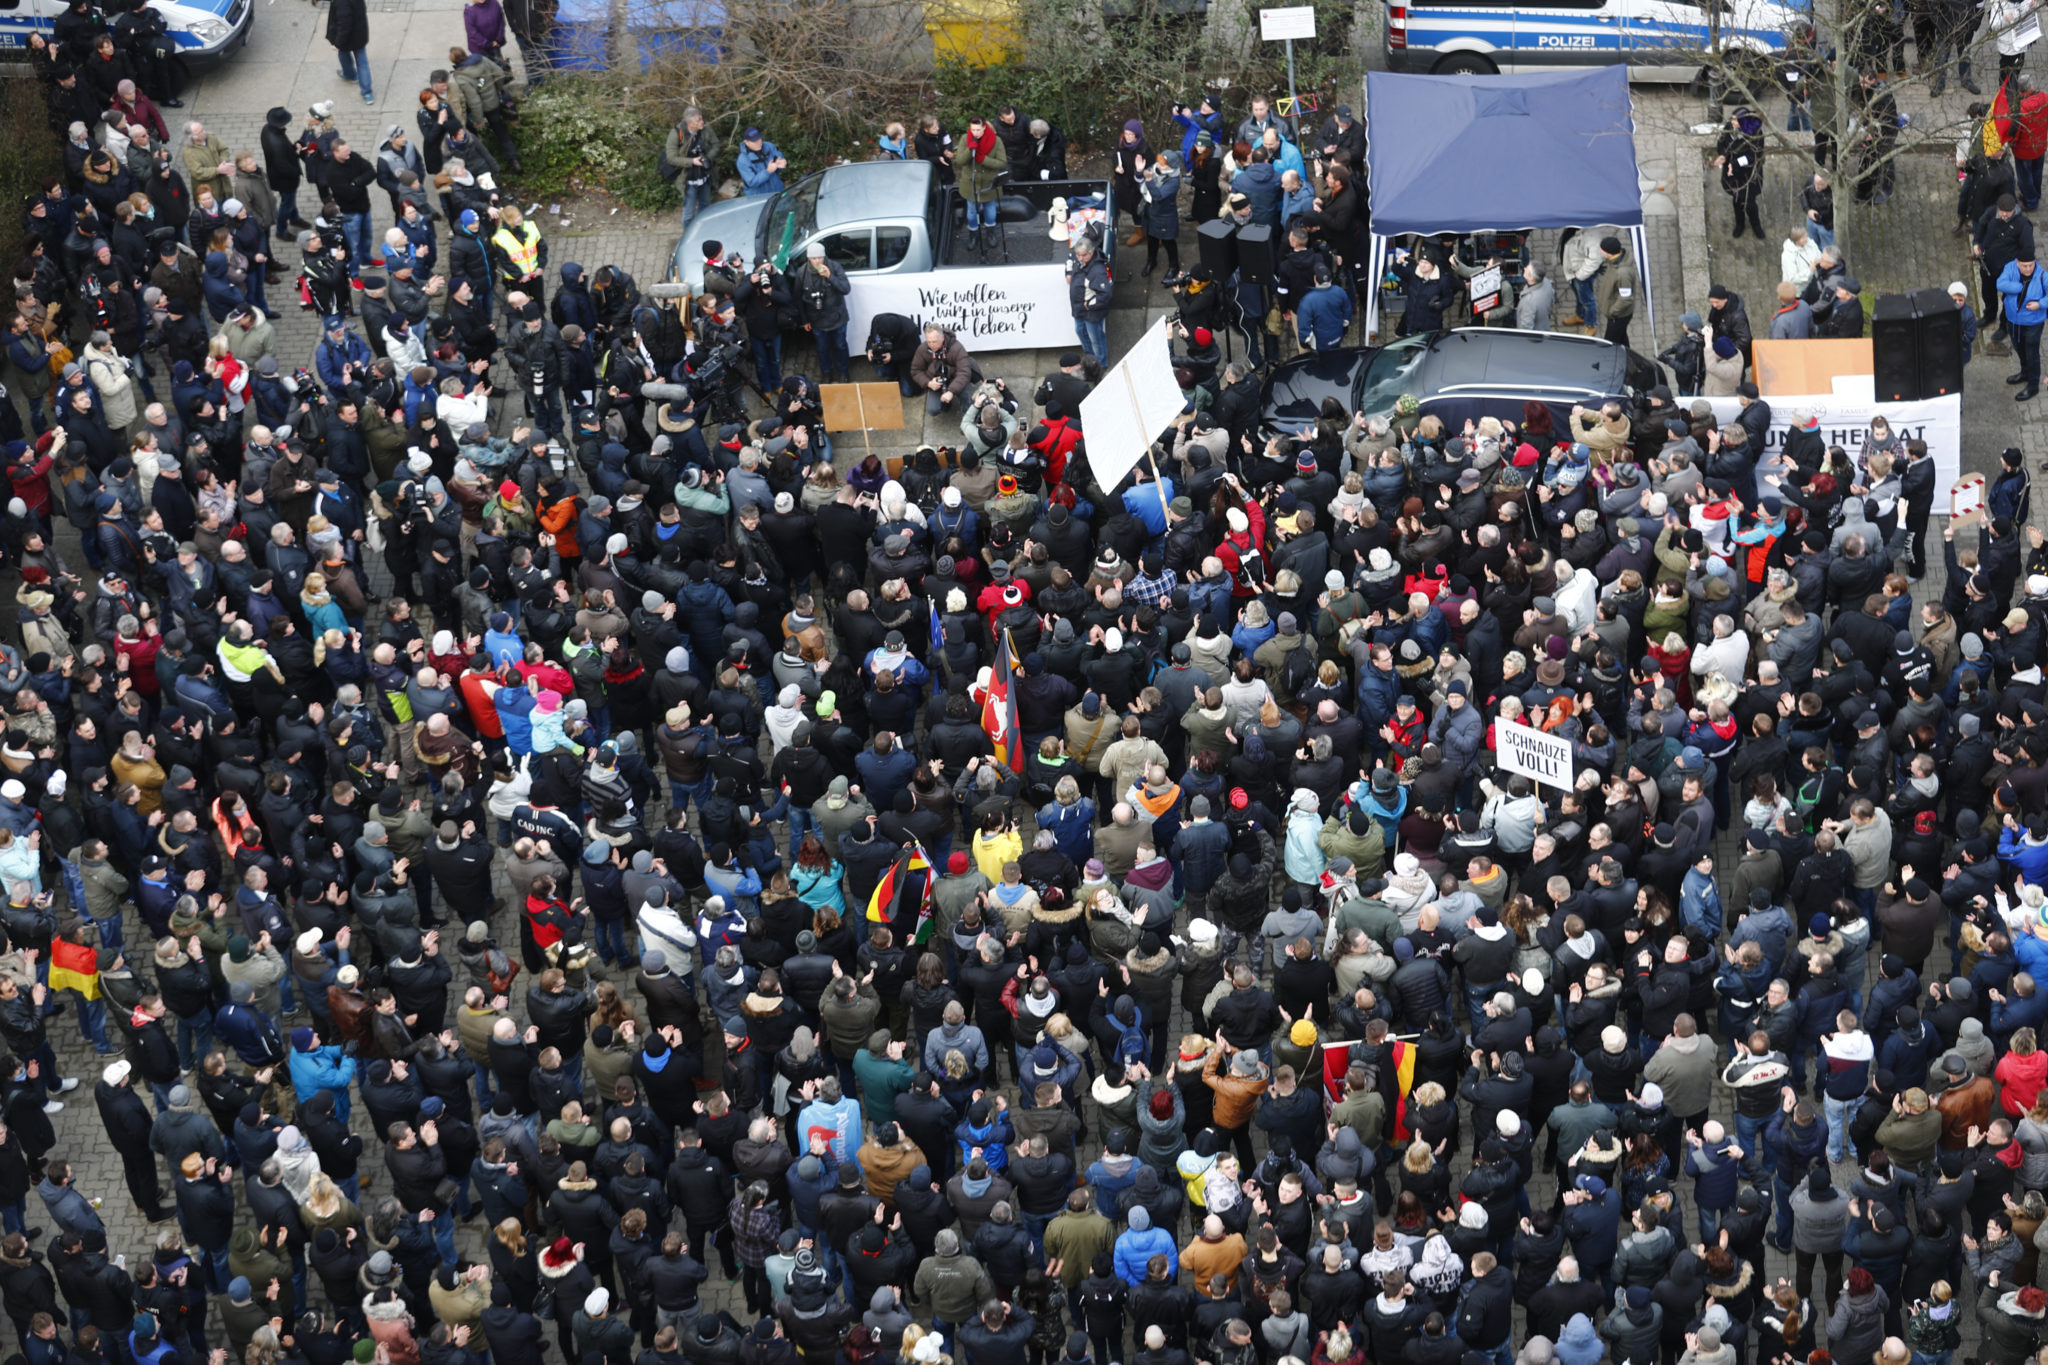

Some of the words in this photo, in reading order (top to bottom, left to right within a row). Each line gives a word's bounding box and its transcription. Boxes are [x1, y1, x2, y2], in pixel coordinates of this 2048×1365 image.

[1538, 35, 1596, 47] POLIZEI
[918, 286, 949, 308] Wie
[953, 283, 1008, 304] wollen
[936, 302, 964, 319] wir
[970, 302, 987, 318] in
[988, 302, 1037, 316] unserer
[1831, 425, 1926, 445] HEIAT
[1505, 729, 1568, 763] SCHNAUZE
[1515, 748, 1558, 779] VOLL!
[517, 818, 535, 832] CAD
